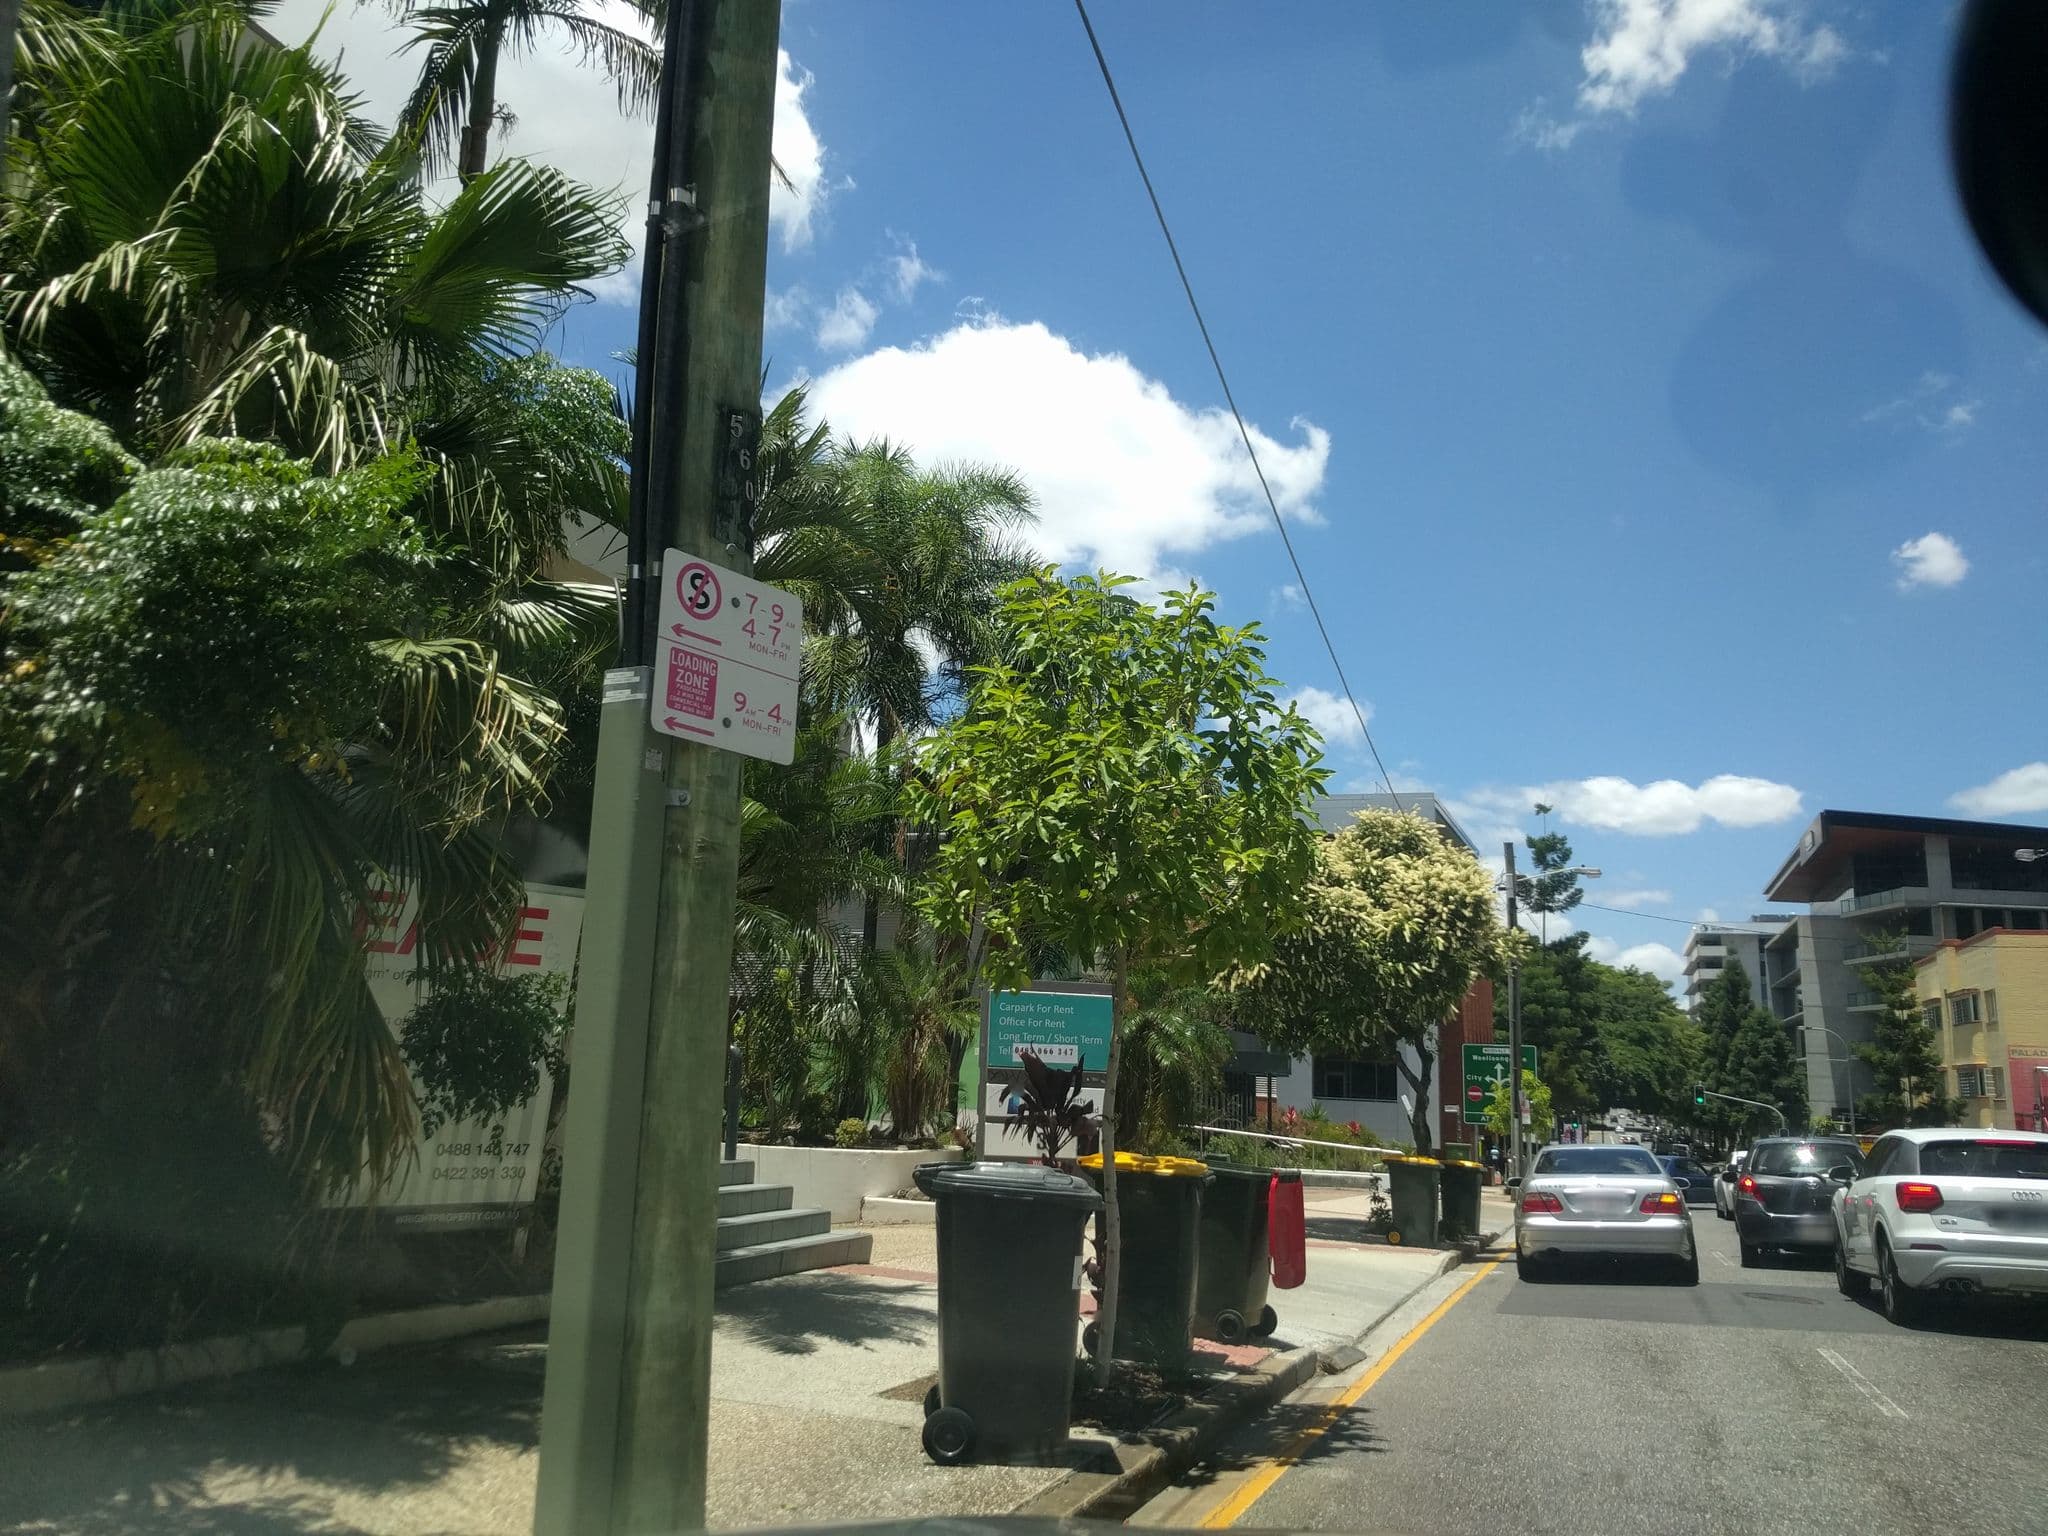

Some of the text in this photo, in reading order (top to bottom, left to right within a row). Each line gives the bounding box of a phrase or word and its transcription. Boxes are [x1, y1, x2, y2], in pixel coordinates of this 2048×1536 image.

[749, 641, 787, 661] MON-FRI
[671, 650, 717, 676] LOADING
[675, 668, 710, 691] ZONE
[742, 717, 782, 737] MON-FRI
[999, 1002, 1075, 1015] Carpark For Rent
[999, 1016, 1065, 1028] Office For Rent
[998, 1031, 1020, 1043] Long
[1022, 1032, 1045, 1042] Term
[1054, 1033, 1078, 1044] Short
[1081, 1035, 1103, 1045] Term
[1466, 1074, 1482, 1082] City
[436, 1143, 471, 1156] 0488
[505, 1143, 531, 1156] 747
[432, 1166, 526, 1180] 0422 391 330
